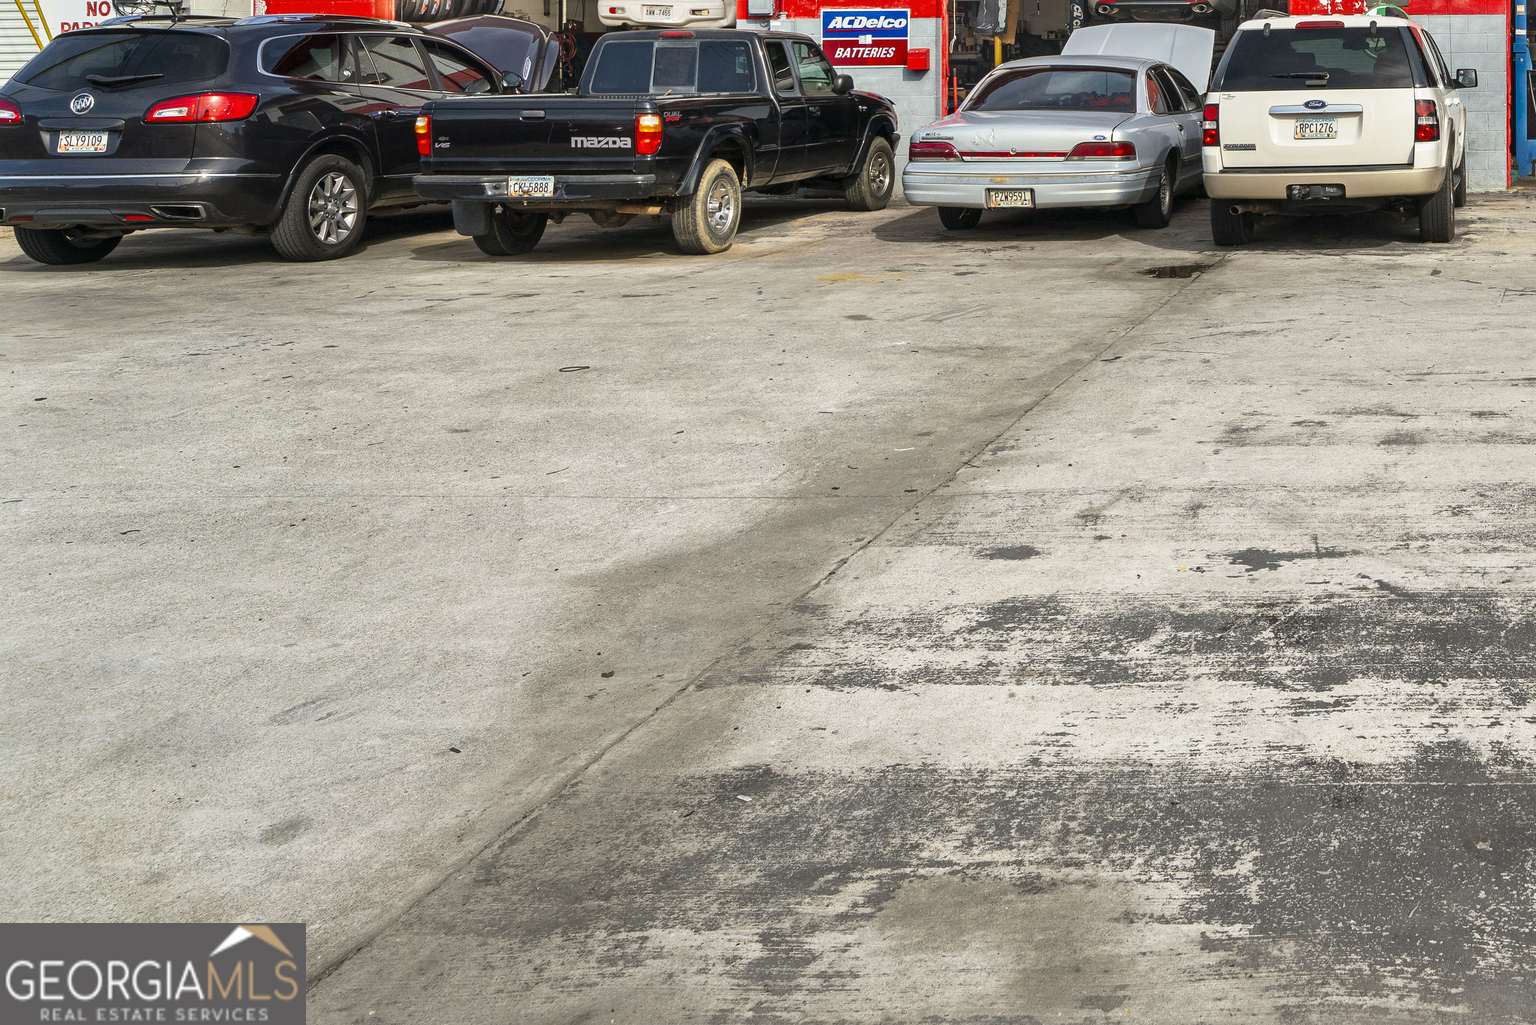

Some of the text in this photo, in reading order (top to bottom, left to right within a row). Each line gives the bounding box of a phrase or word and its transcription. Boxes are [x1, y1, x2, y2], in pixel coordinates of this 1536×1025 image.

[86, 1, 111, 17] NO
[828, 16, 907, 29] ACDelco
[835, 47, 896, 58] BATTERIES
[1299, 123, 1333, 133] RPC1276
[64, 135, 103, 147] SLY9109
[994, 191, 1028, 202] PZW9591
